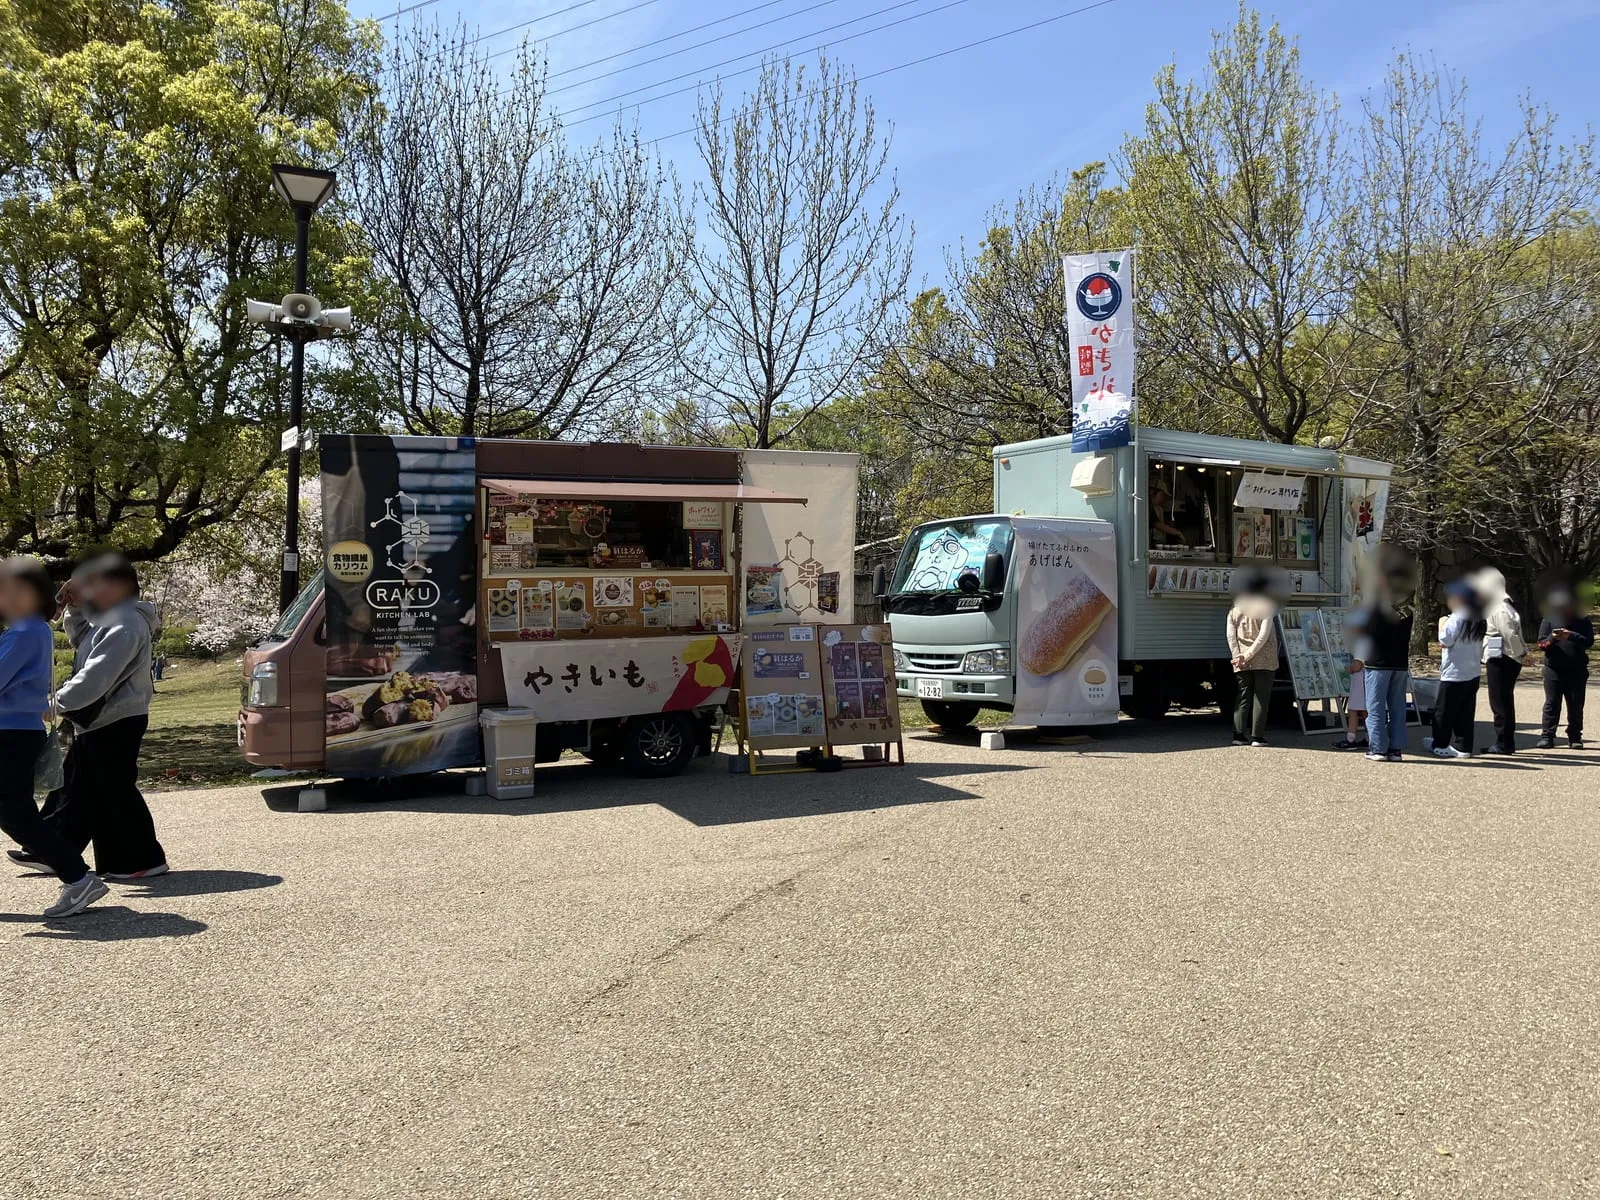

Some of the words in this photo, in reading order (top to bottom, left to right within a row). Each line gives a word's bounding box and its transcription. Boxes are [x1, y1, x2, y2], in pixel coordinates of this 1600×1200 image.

[613, 546, 644, 555] 紅はるか
[1028, 541, 1089, 553] 揚げたてふわふわの
[333, 553, 368, 563] 食物繊維
[1029, 553, 1073, 569] あげぱん
[333, 562, 369, 571] カリウム
[376, 587, 430, 602] RAKU
[376, 611, 411, 619] KITCHEN
[773, 655, 803, 663] 紅はるか
[524, 660, 646, 694] やきいも
[505, 766, 530, 776] ゴミ箱
